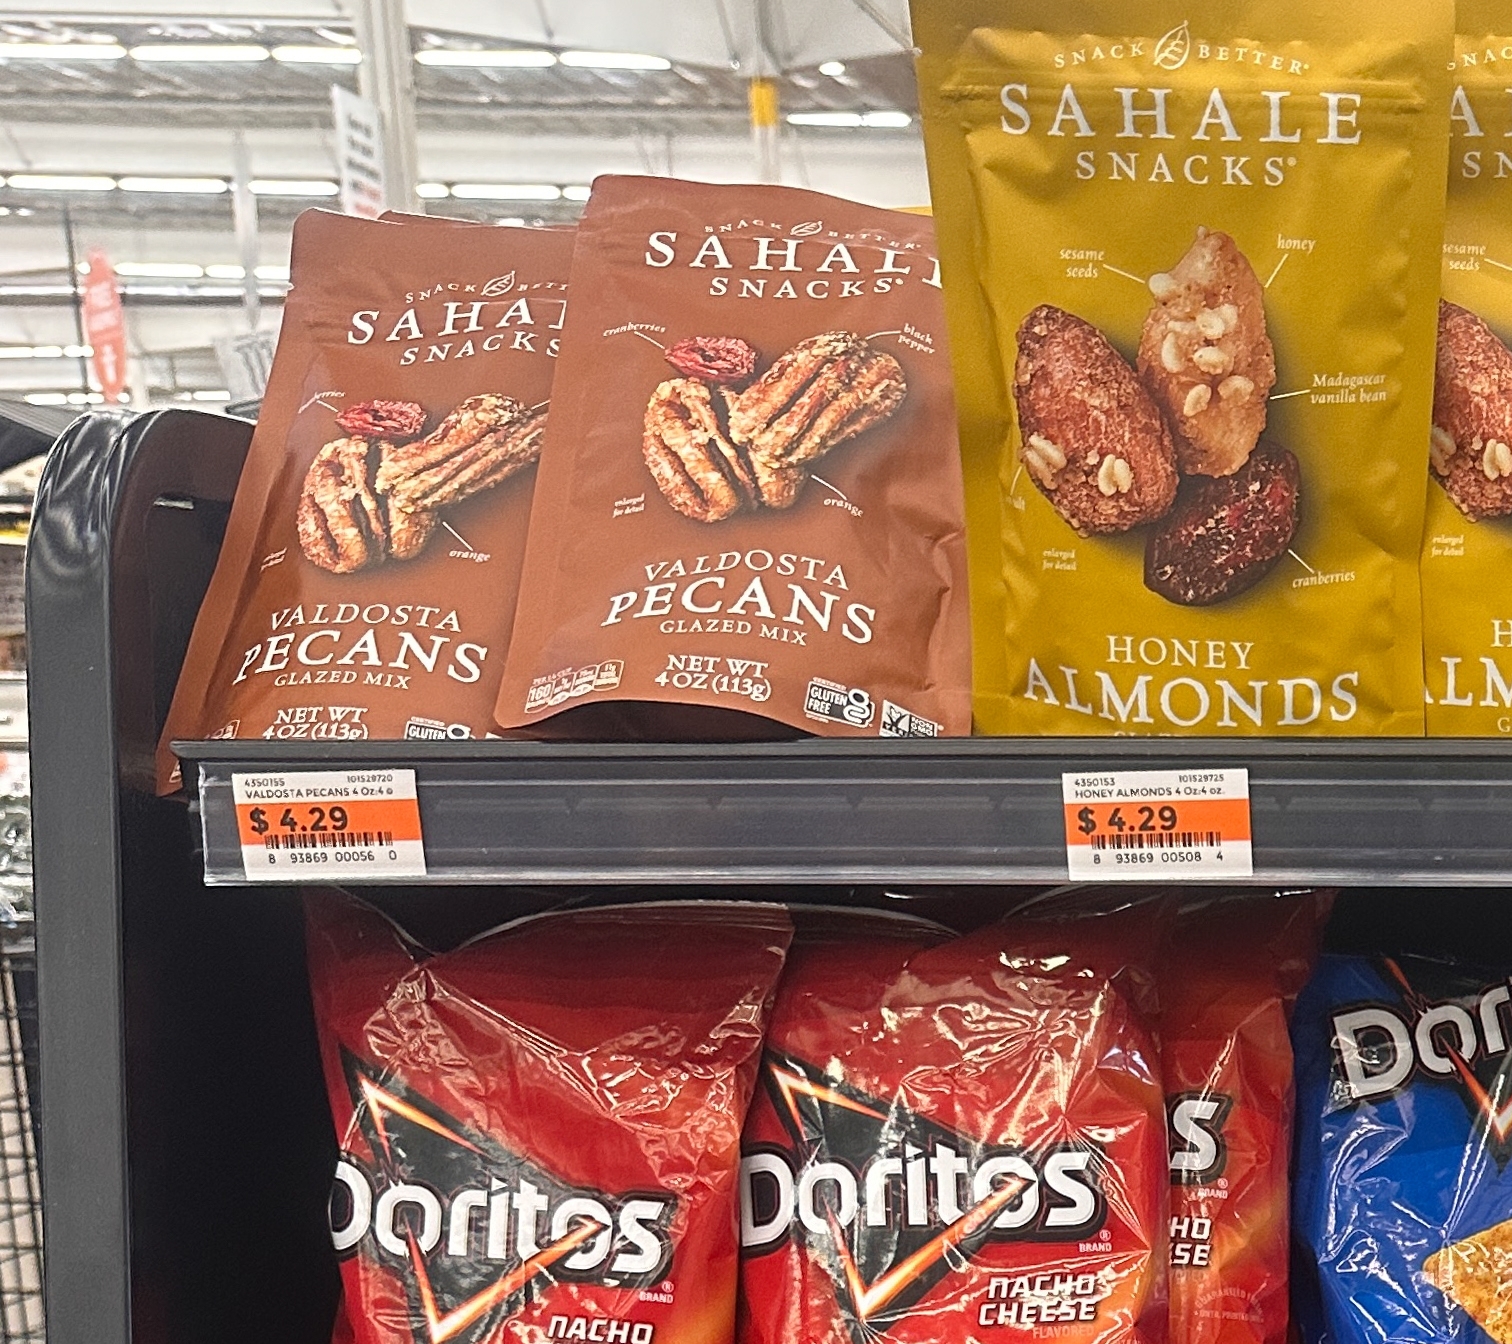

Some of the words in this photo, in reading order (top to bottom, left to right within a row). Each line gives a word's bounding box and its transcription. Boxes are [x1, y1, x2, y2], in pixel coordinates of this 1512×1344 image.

[1055, 42, 1144, 68] SNACK
[1199, 44, 1302, 75] BETTER
[1001, 83, 1362, 145] SAHALE
[1076, 151, 1285, 187] SNACKS
[1060, 247, 1104, 261] sesame
[1277, 234, 1316, 255] honey
[1066, 263, 1099, 279] seeds
[709, 277, 892, 299] SNACKS
[603, 322, 666, 336] cranberries
[400, 331, 561, 365] SNACKS
[1310, 389, 1356, 404] vanilla
[1360, 388, 1386, 402] bean
[1312, 373, 1385, 391] Madagascar
[824, 498, 863, 517] orange
[645, 549, 849, 590] VALDOSTA
[1292, 570, 1355, 588] cranberries
[272, 604, 461, 632] VALDOSTA
[600, 577, 876, 645] PECANS
[660, 619, 752, 635] GLAZED
[759, 623, 807, 645] MIX
[233, 629, 487, 685] PECANS
[1107, 635, 1254, 670] HONEY
[1024, 657, 1360, 728] ALMONDS
[1075, 778, 1115, 787] 4350153
[1075, 789, 1113, 798] HONEY
[1117, 788, 1172, 797] ALMONDS
[250, 807, 268, 835] $
[281, 806, 348, 831] 4.29
[1078, 807, 1096, 835] $
[1108, 806, 1177, 831] 4.29
[741, 1143, 1096, 1247] Doritos
[328, 1160, 664, 1273] Doritos
